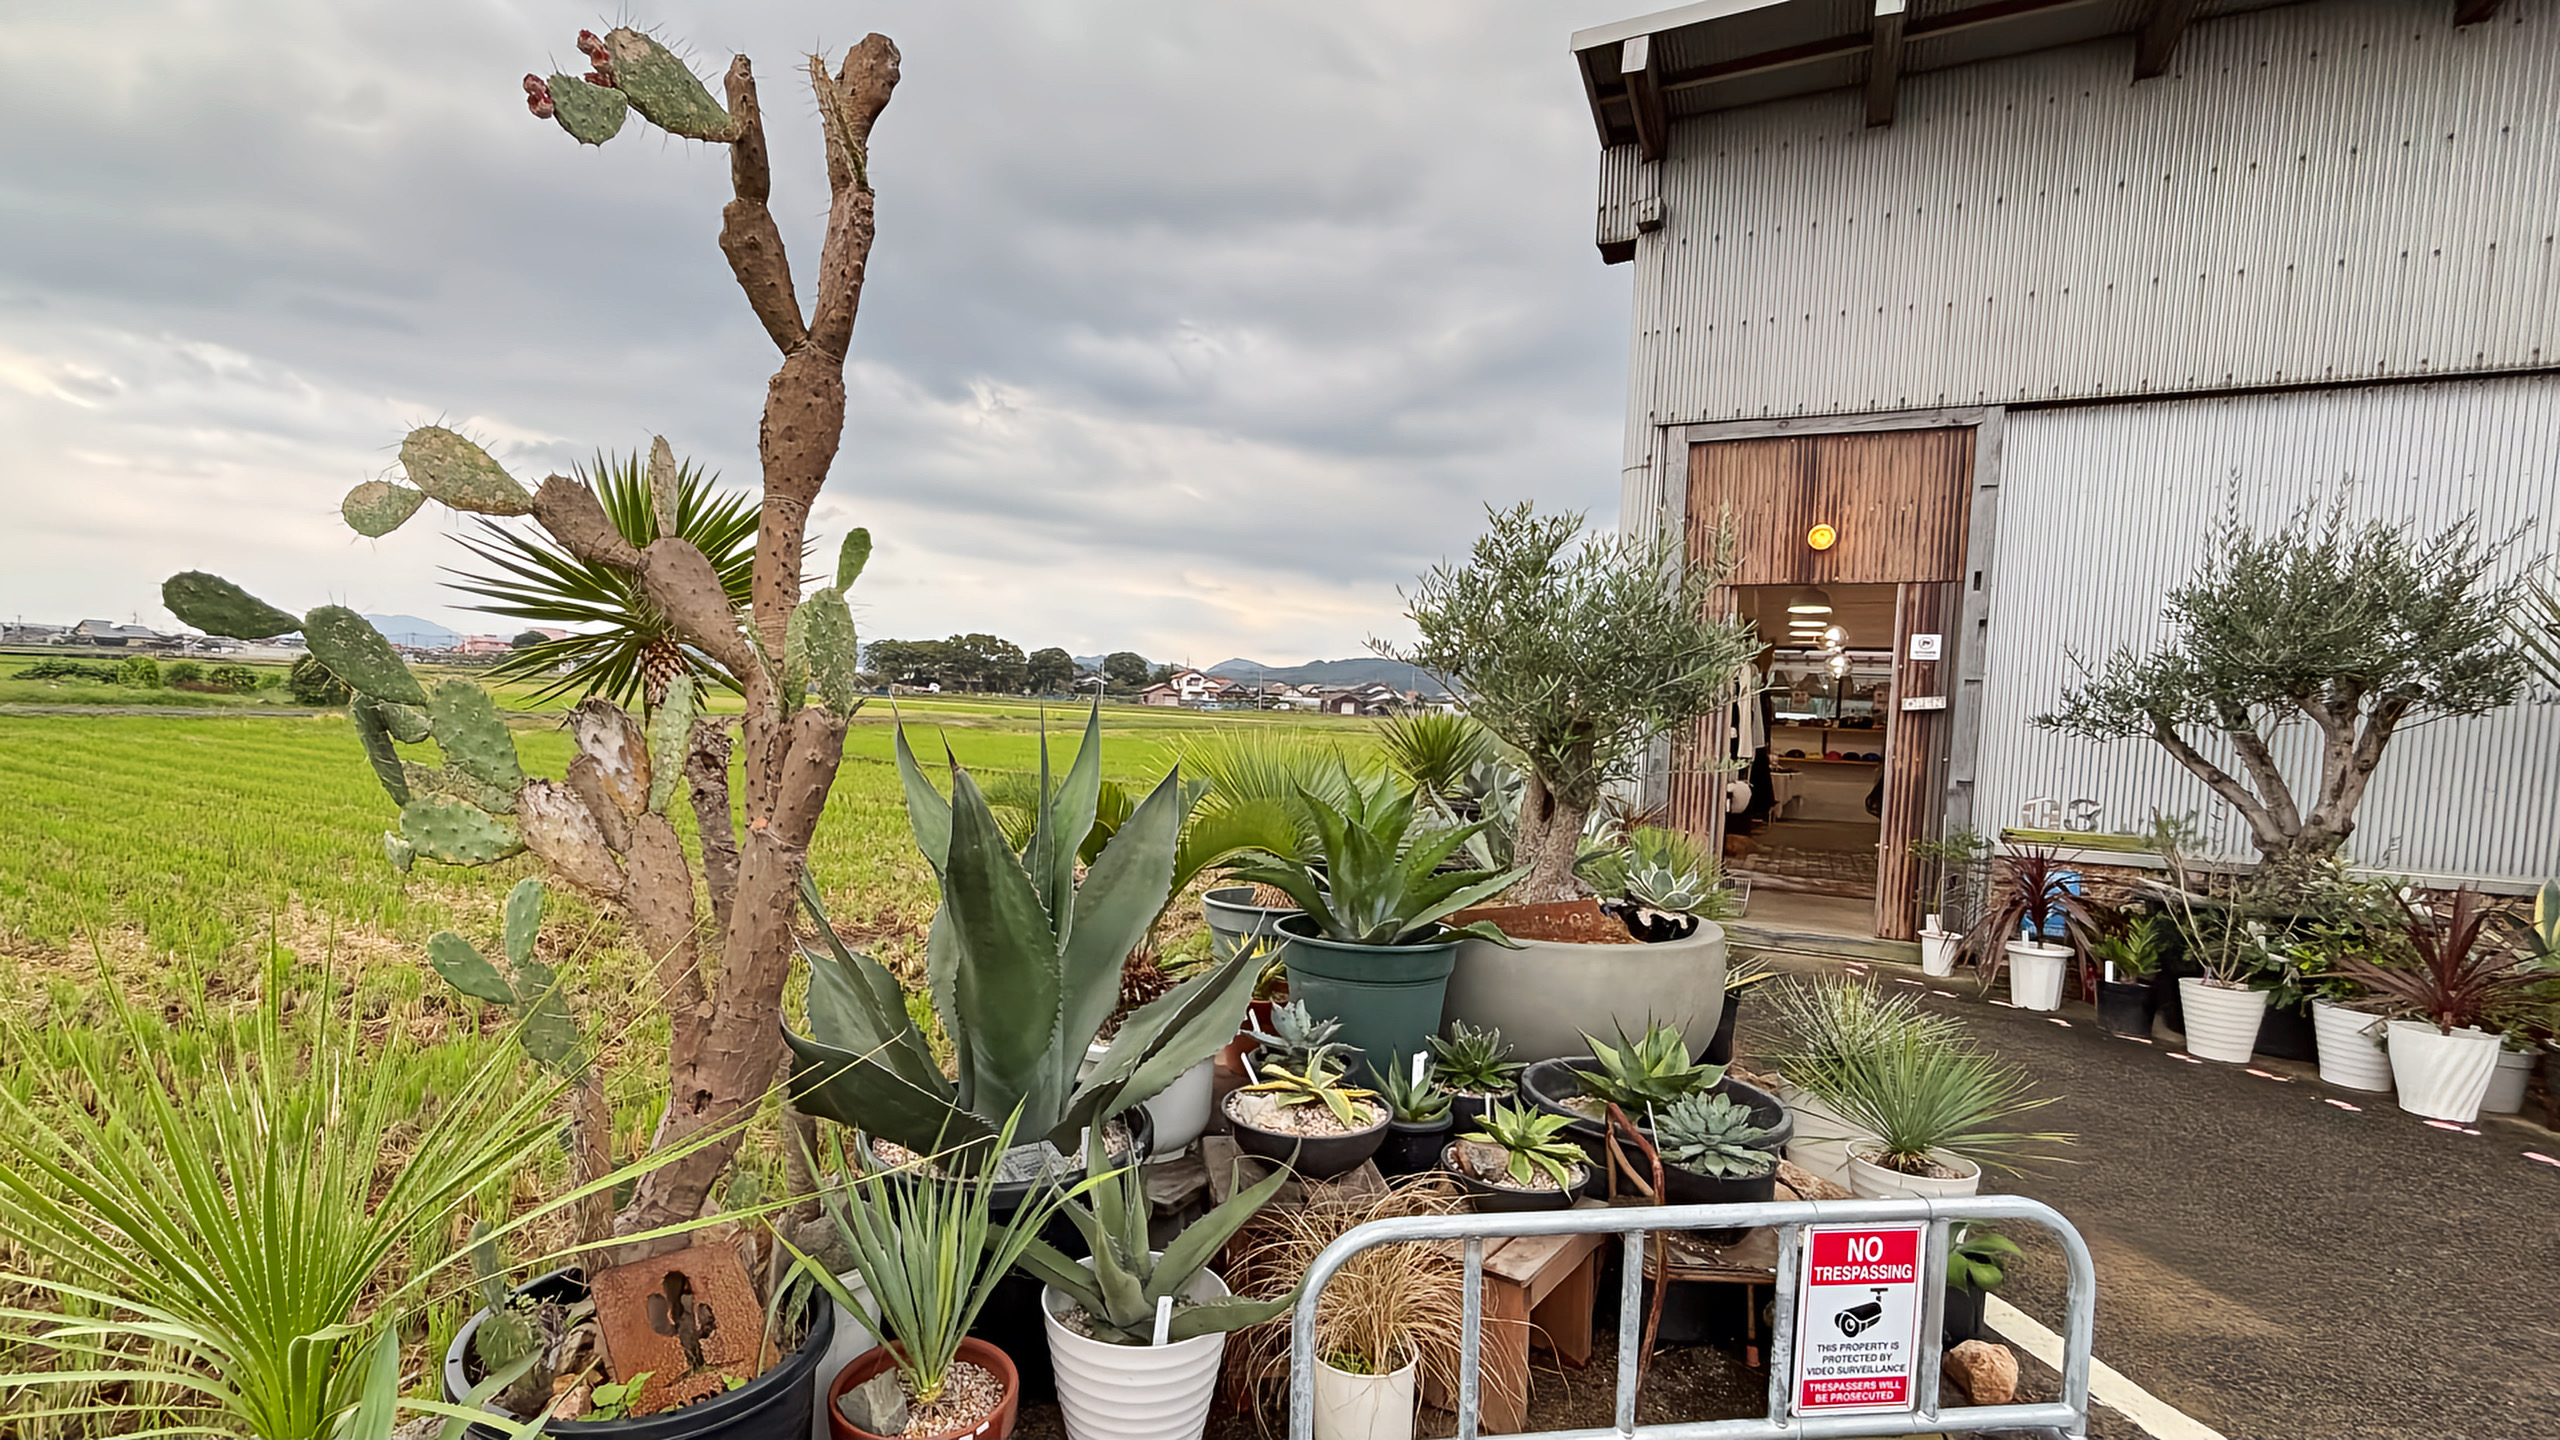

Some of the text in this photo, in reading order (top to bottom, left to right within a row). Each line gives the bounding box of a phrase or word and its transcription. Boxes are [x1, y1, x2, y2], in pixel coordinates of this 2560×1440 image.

[1847, 1235, 1884, 1263] NO
[1814, 1263, 1913, 1281] TRESPASSING
[1817, 1341, 1900, 1353] THIS PROPERTY IS
[1822, 1353, 1893, 1364] PROTECTED BY
[1806, 1363, 1906, 1376] VIDEO SURVEILLANCE
[1809, 1380, 1902, 1392] TRESPASSERS WILL
[1815, 1390, 1895, 1403] BE PROSECUTED
